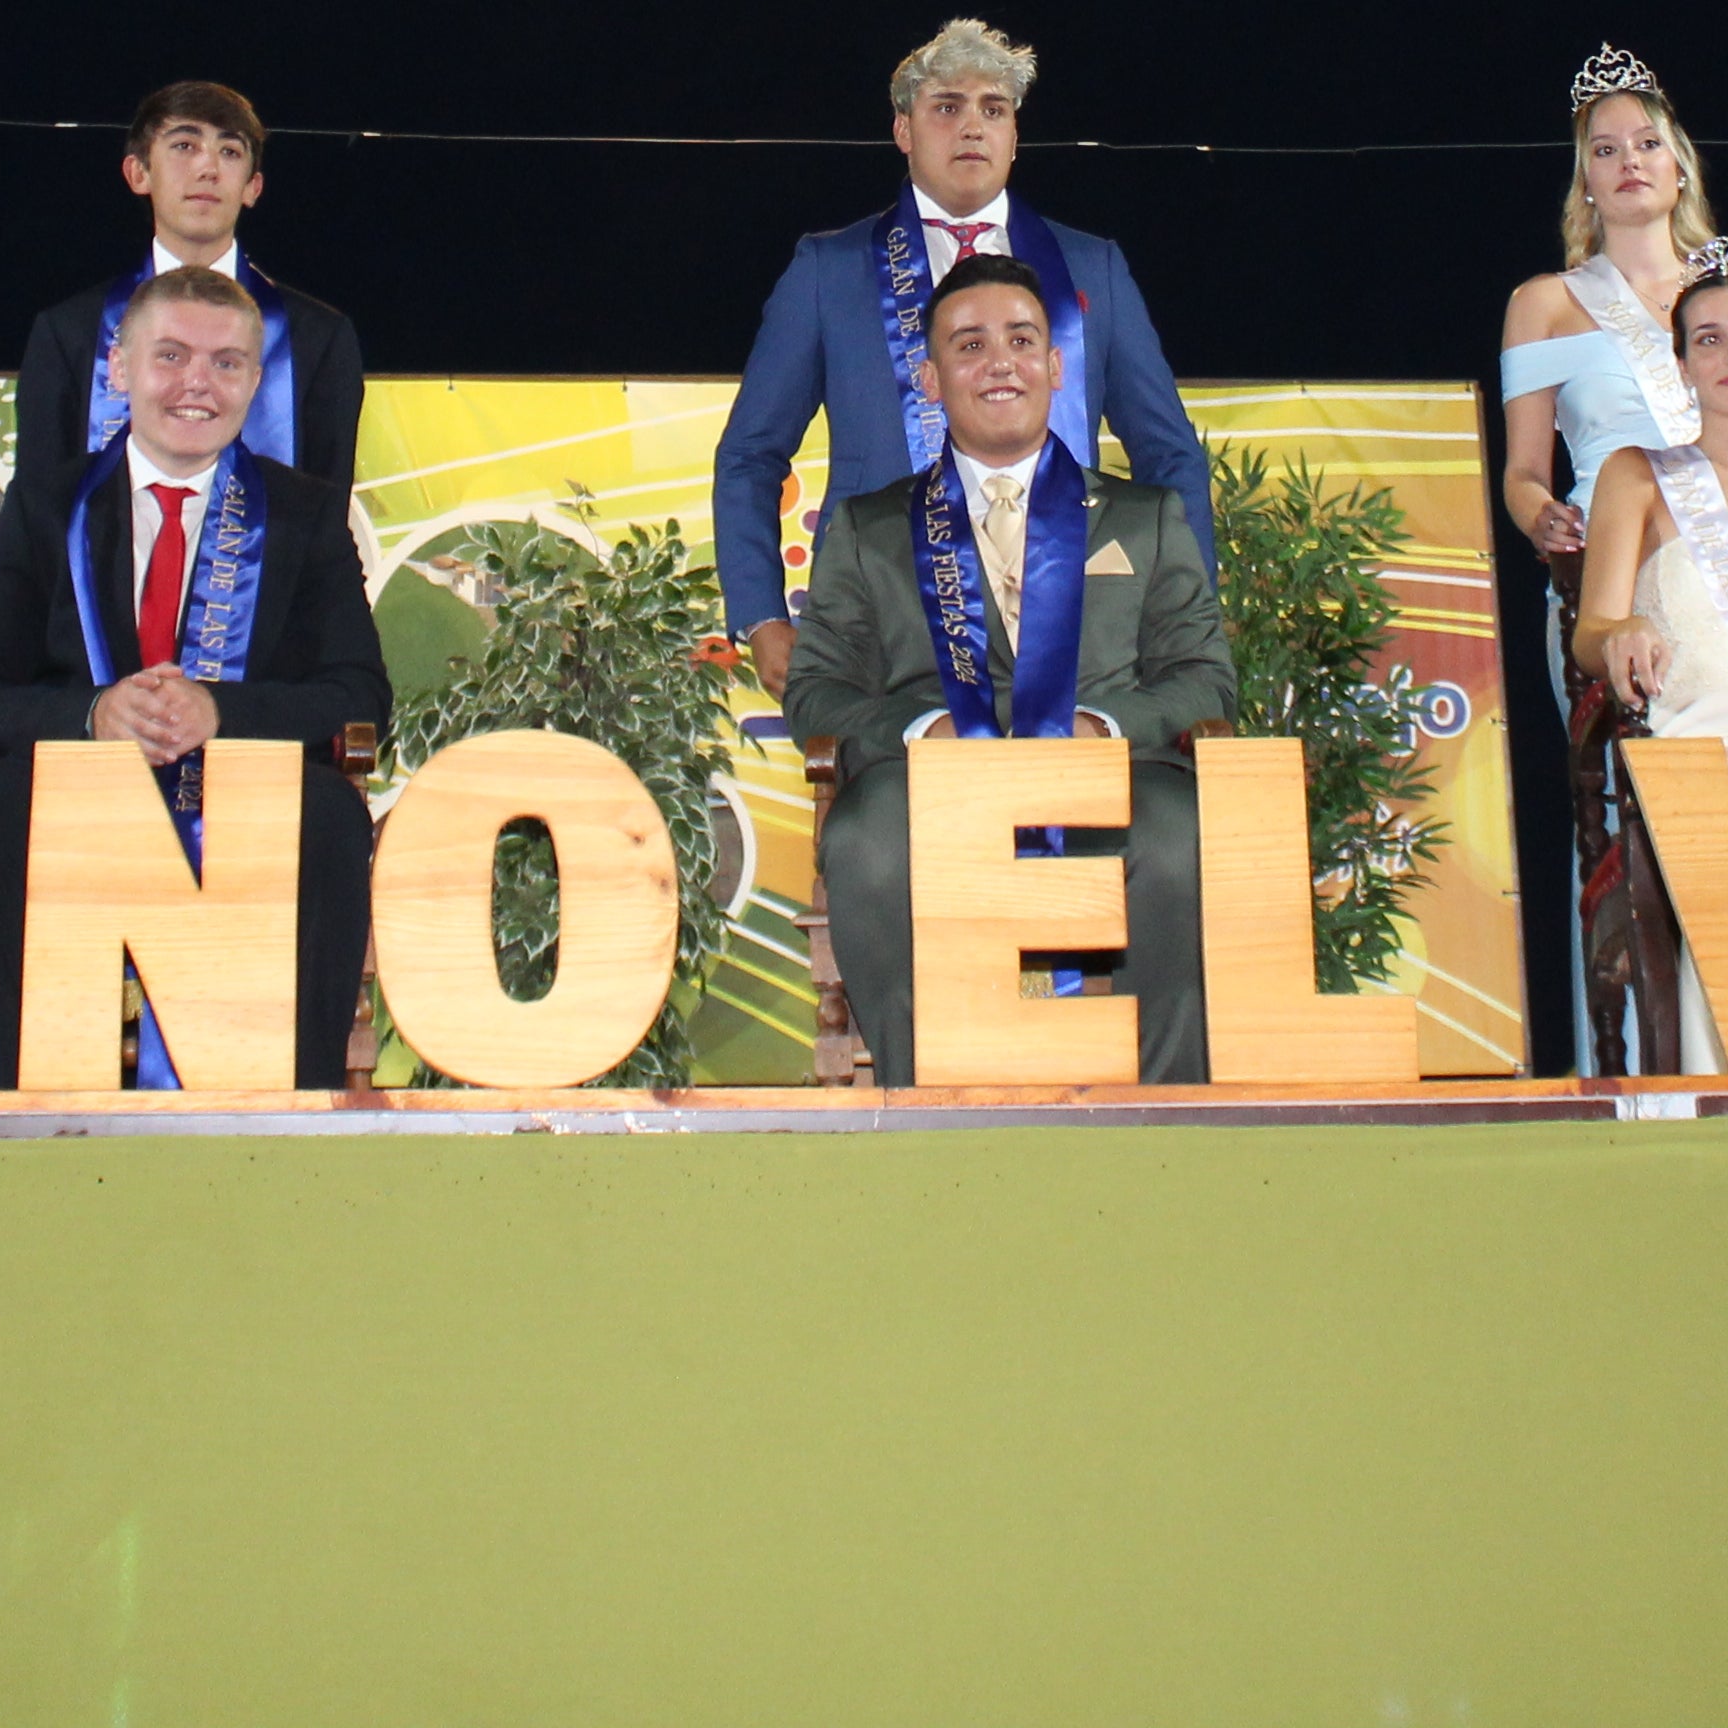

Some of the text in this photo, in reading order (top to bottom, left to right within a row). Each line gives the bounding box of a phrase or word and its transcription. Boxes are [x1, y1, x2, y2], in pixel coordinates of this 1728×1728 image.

[896, 307, 920, 337] DE
[926, 504, 952, 545] LAS
[209, 559, 238, 593] DE
[932, 551, 968, 638] FIESTAS
[199, 601, 231, 649] LAS
[949, 641, 978, 685] 2024
[907, 736, 1420, 1086] EL
